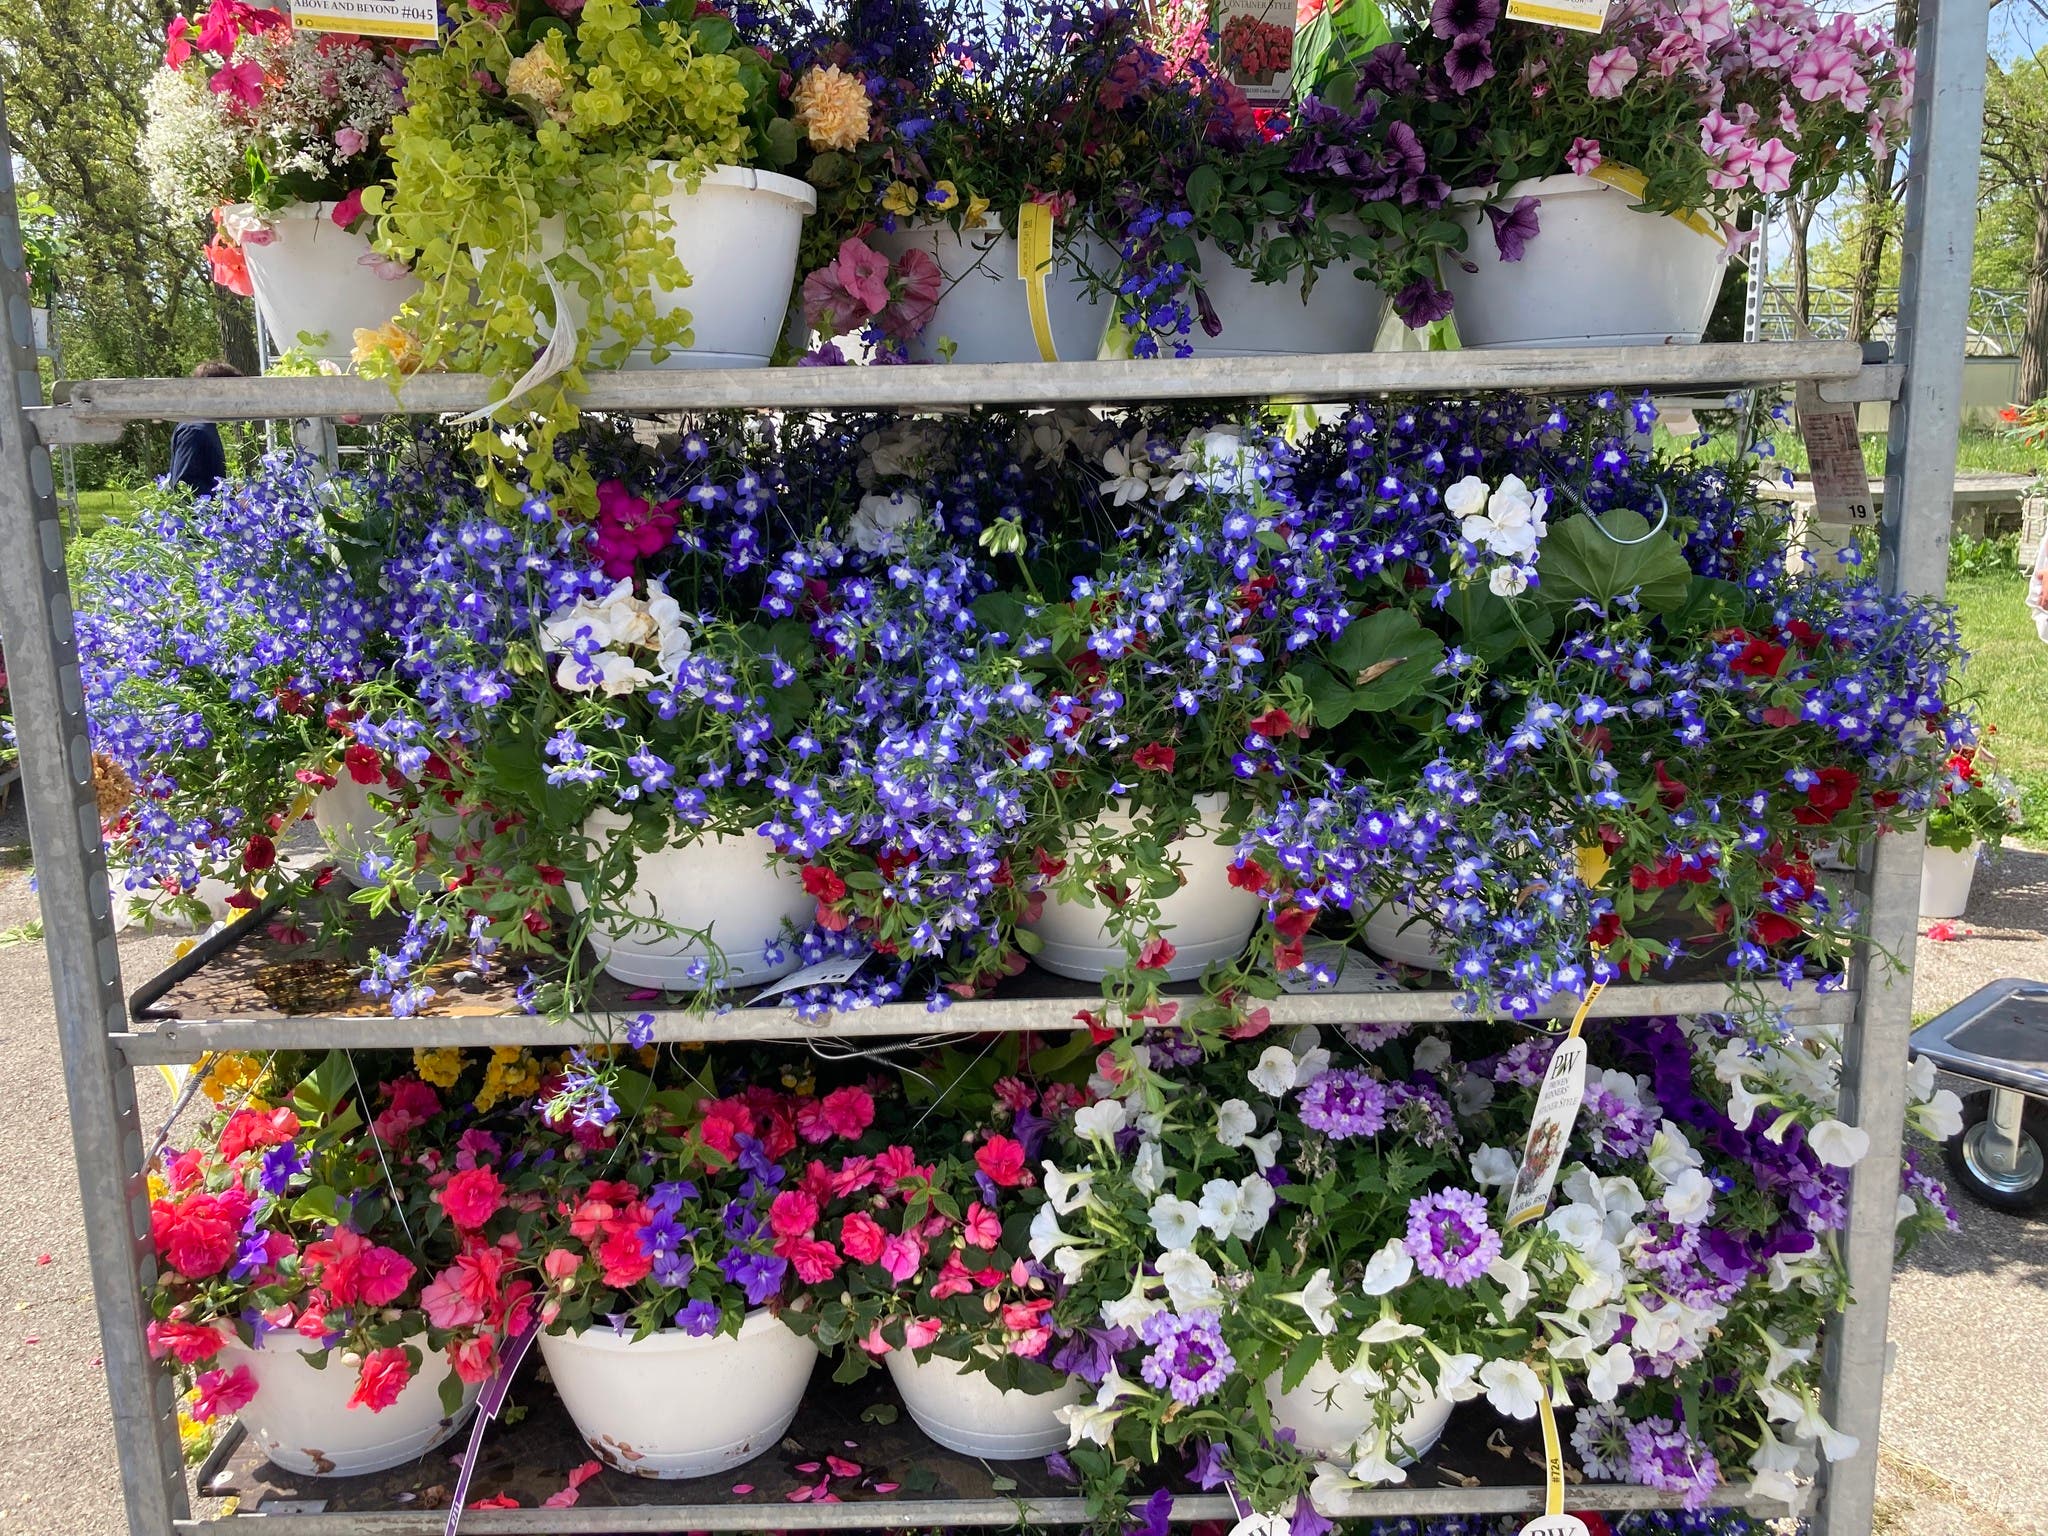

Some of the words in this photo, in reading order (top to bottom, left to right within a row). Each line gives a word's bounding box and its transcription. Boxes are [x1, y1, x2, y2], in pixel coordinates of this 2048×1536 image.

[294, 0, 329, 10] ABOVE
[331, 2, 355, 12] AND
[357, 2, 399, 15] BEYOND
[401, 6, 434, 20] #045
[1849, 505, 1867, 519] 19
[1551, 1050, 1581, 1079] PW
[1550, 1458, 1560, 1483] #724
